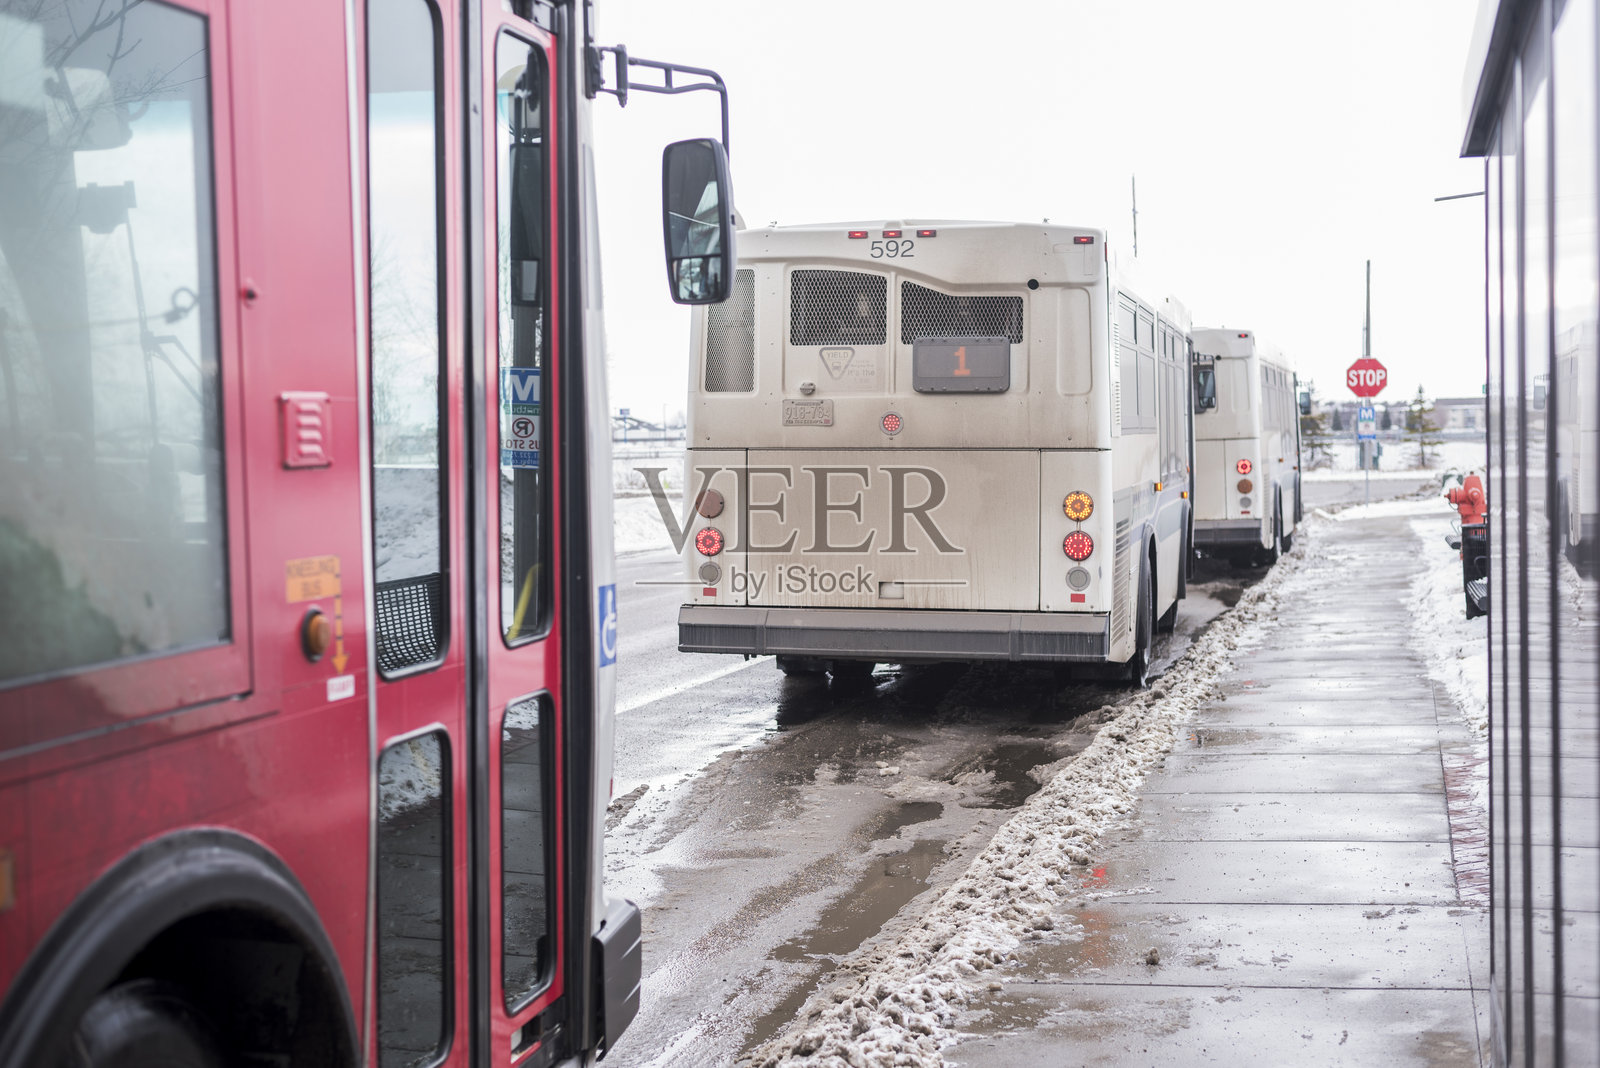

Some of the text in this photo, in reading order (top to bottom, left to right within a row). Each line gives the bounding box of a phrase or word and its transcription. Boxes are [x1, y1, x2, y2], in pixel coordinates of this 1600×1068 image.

[870, 239, 915, 259] 592
[826, 351, 849, 359] YIELD
[953, 346, 971, 376] 1
[862, 369, 875, 377] the
[1348, 369, 1386, 387] STOP
[1361, 408, 1373, 419] M
